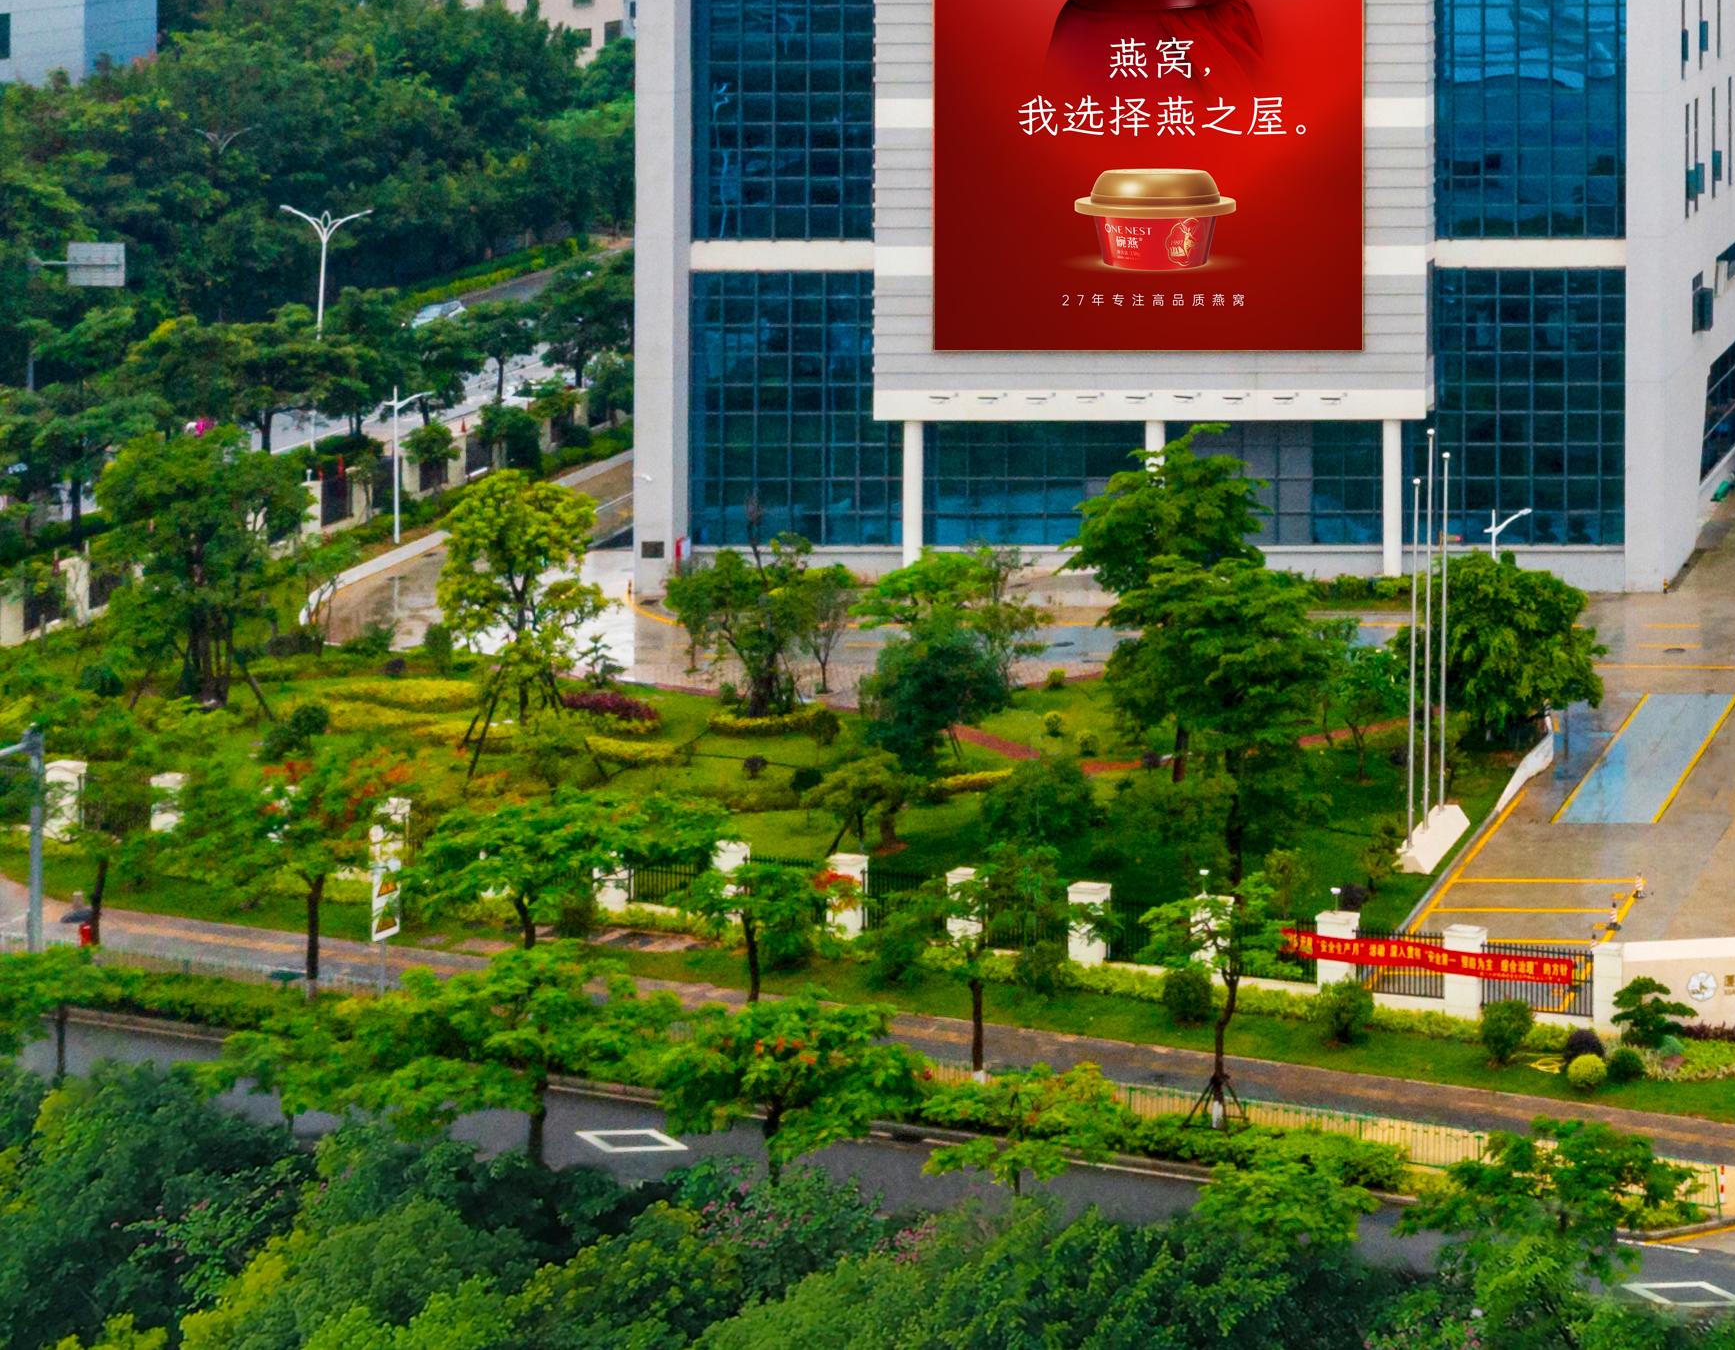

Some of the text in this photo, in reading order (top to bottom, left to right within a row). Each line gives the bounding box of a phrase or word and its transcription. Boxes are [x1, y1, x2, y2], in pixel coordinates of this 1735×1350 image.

[1018, 95, 1307, 137] 我选择燕之屋。
[1105, 223, 1152, 236] ONE NEST
[1062, 293, 1245, 307] 27年专注高品质燕窝
